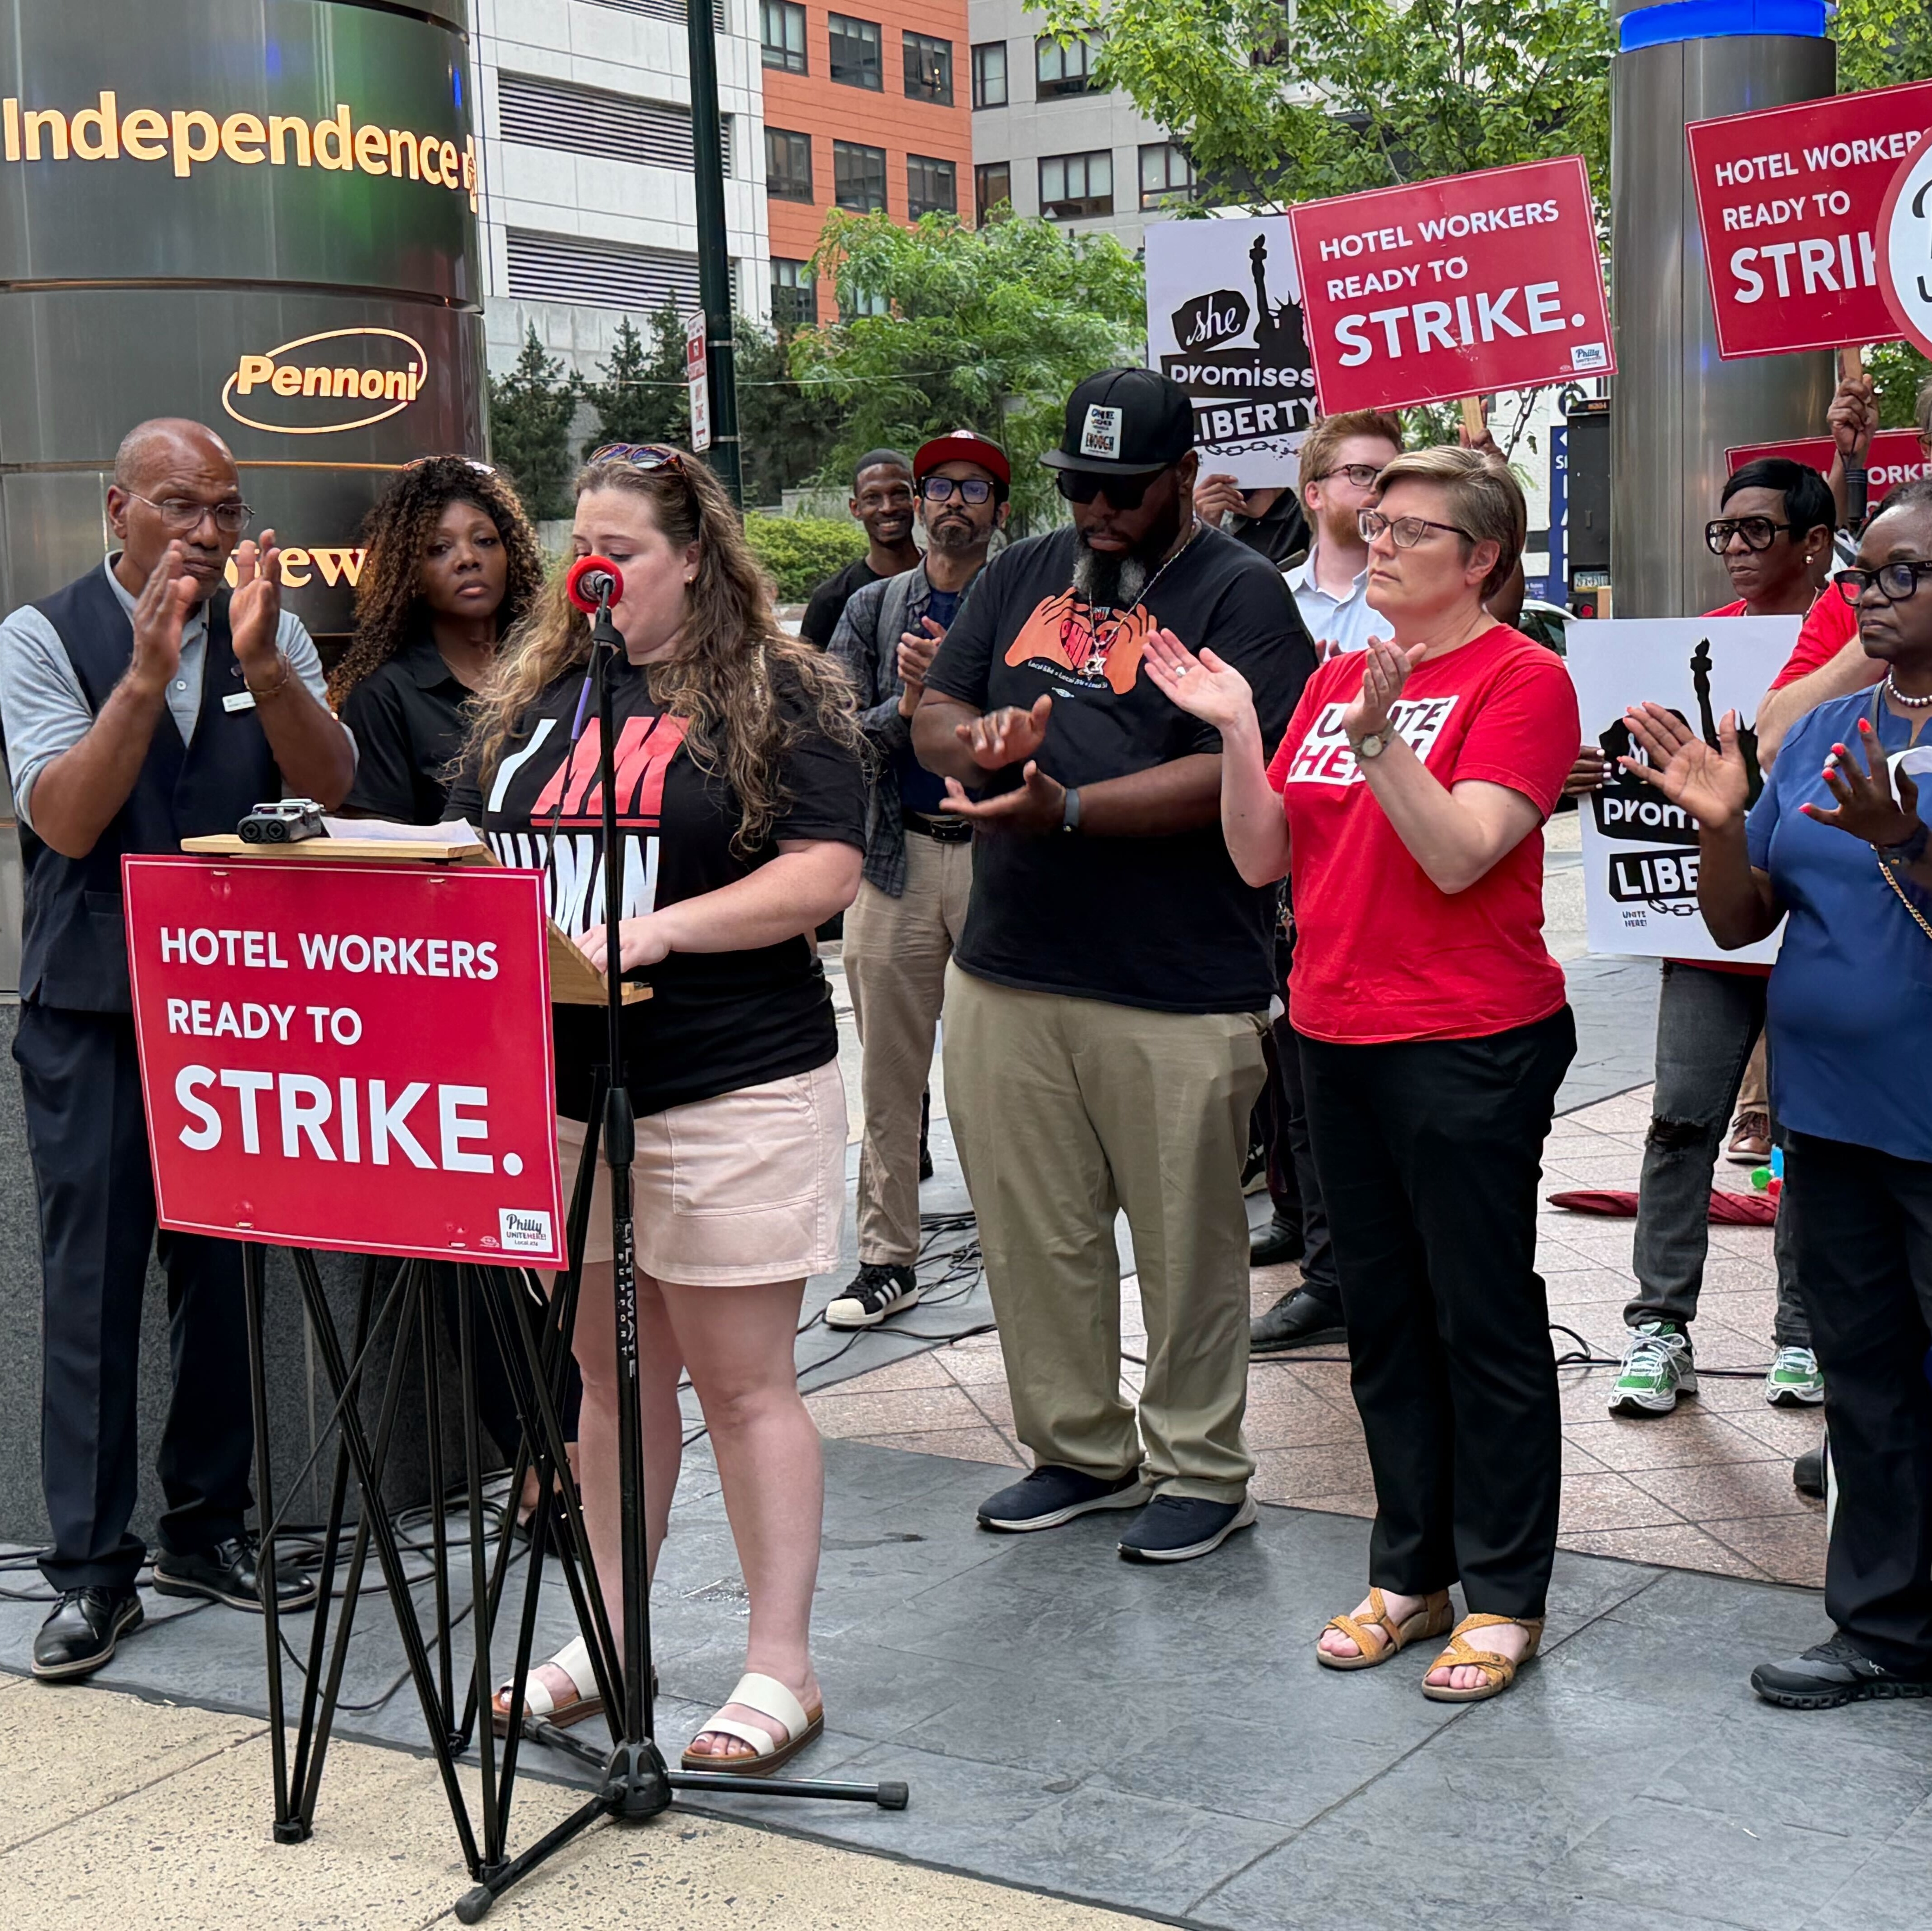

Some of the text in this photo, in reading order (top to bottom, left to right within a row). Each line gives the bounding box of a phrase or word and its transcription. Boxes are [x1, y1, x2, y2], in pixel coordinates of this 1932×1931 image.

[3, 91, 458, 189] Independence
[1715, 128, 1930, 187] HOTEL WORKER
[1320, 200, 1559, 261] HOTEL WORKERS
[1722, 190, 1850, 231] READY TO
[1327, 256, 1468, 302] READY TO
[1731, 231, 1876, 303] STRI
[1186, 295, 1241, 346] she
[1334, 281, 1585, 367] STRIKE.
[237, 355, 417, 401] Pennoni
[1170, 358, 1315, 388] promises
[1194, 396, 1318, 442] IBERTY
[1317, 700, 1451, 738] UITE
[160, 927, 499, 980] HOTEL WORKERS
[167, 998, 362, 1045] READY TO
[175, 1064, 523, 1176] STRIKE.
[506, 1213, 542, 1235] Philly
